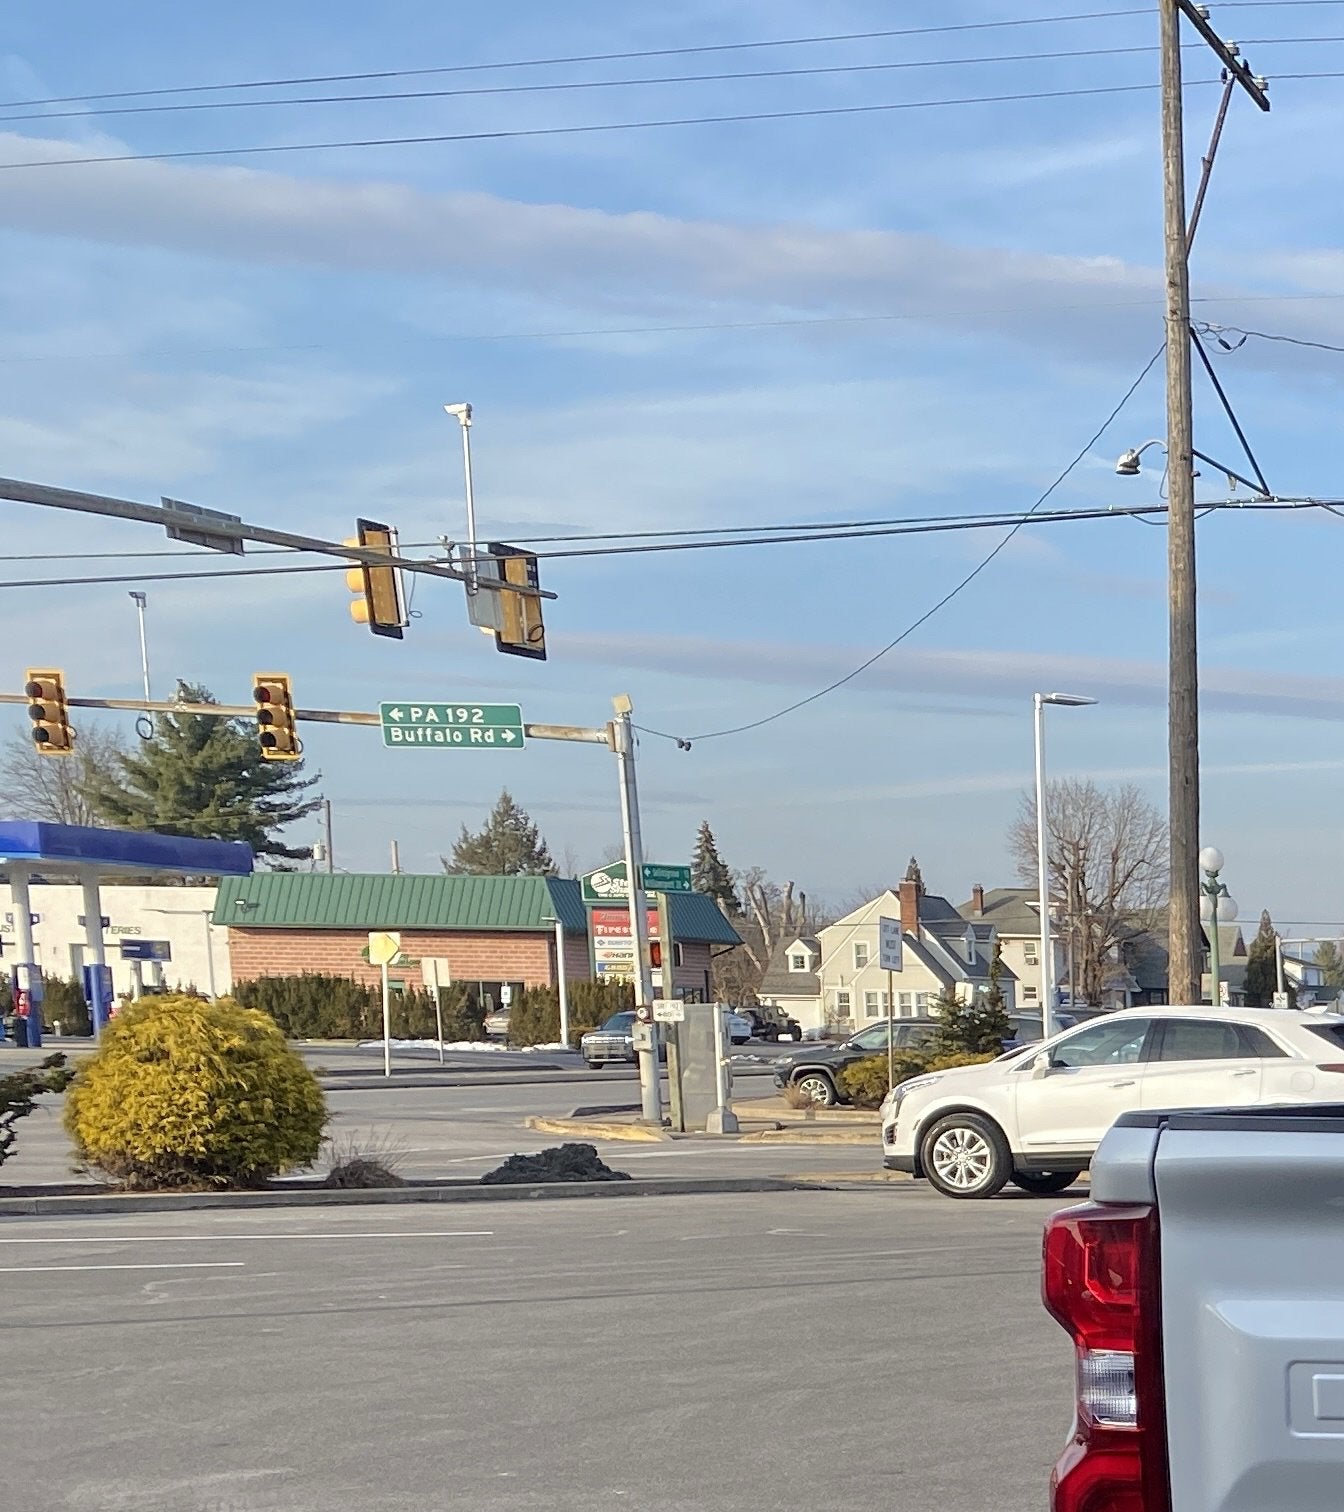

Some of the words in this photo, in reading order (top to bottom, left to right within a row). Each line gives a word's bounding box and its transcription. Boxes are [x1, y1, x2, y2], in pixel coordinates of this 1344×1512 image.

[410, 707, 439, 723] PA
[446, 708, 484, 723] 192
[390, 727, 463, 743] Buffalo
[469, 728, 494, 743] Rd
